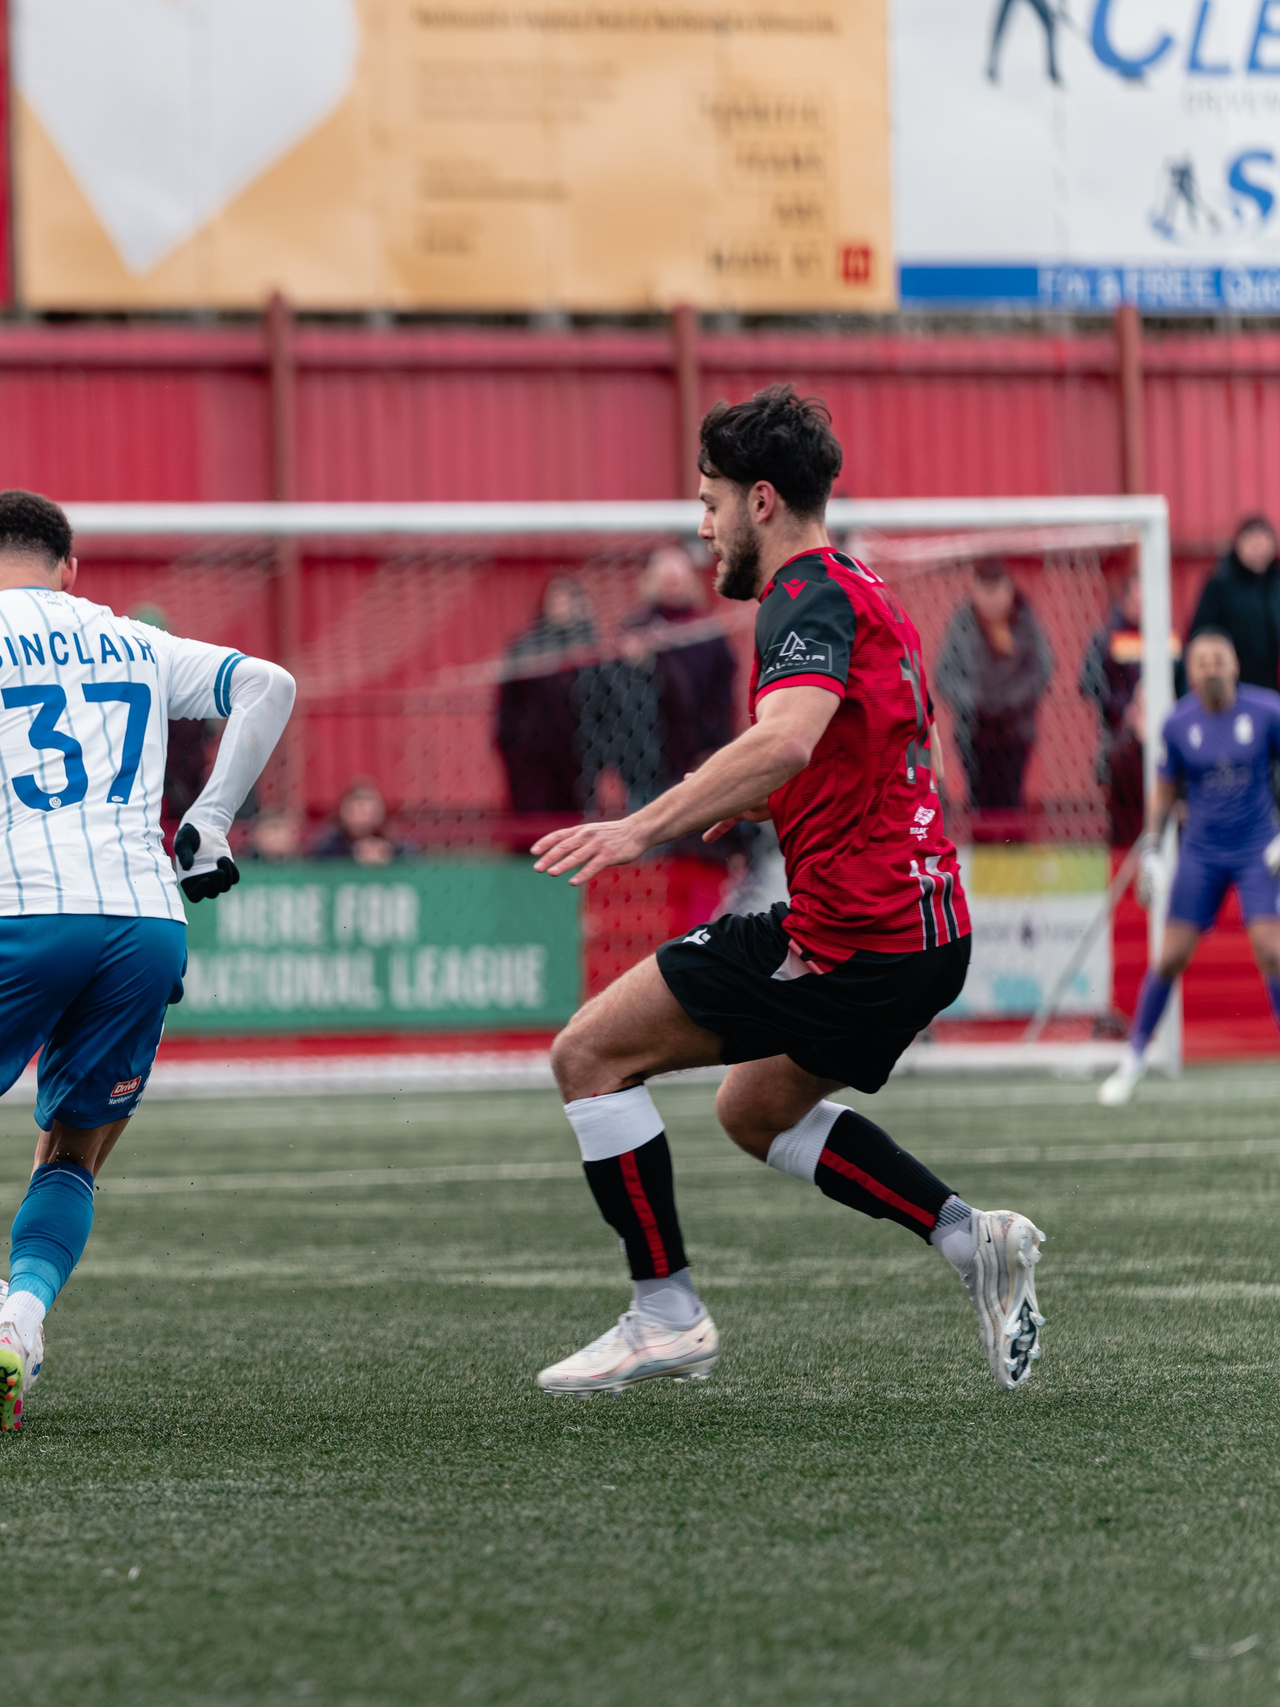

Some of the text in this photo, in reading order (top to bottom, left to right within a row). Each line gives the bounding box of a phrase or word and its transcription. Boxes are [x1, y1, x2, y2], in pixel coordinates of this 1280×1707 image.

[1, 682, 151, 812] 37
[218, 883, 419, 946] HERE FOR
[185, 943, 547, 1012] NATIONAL LEAGUE
